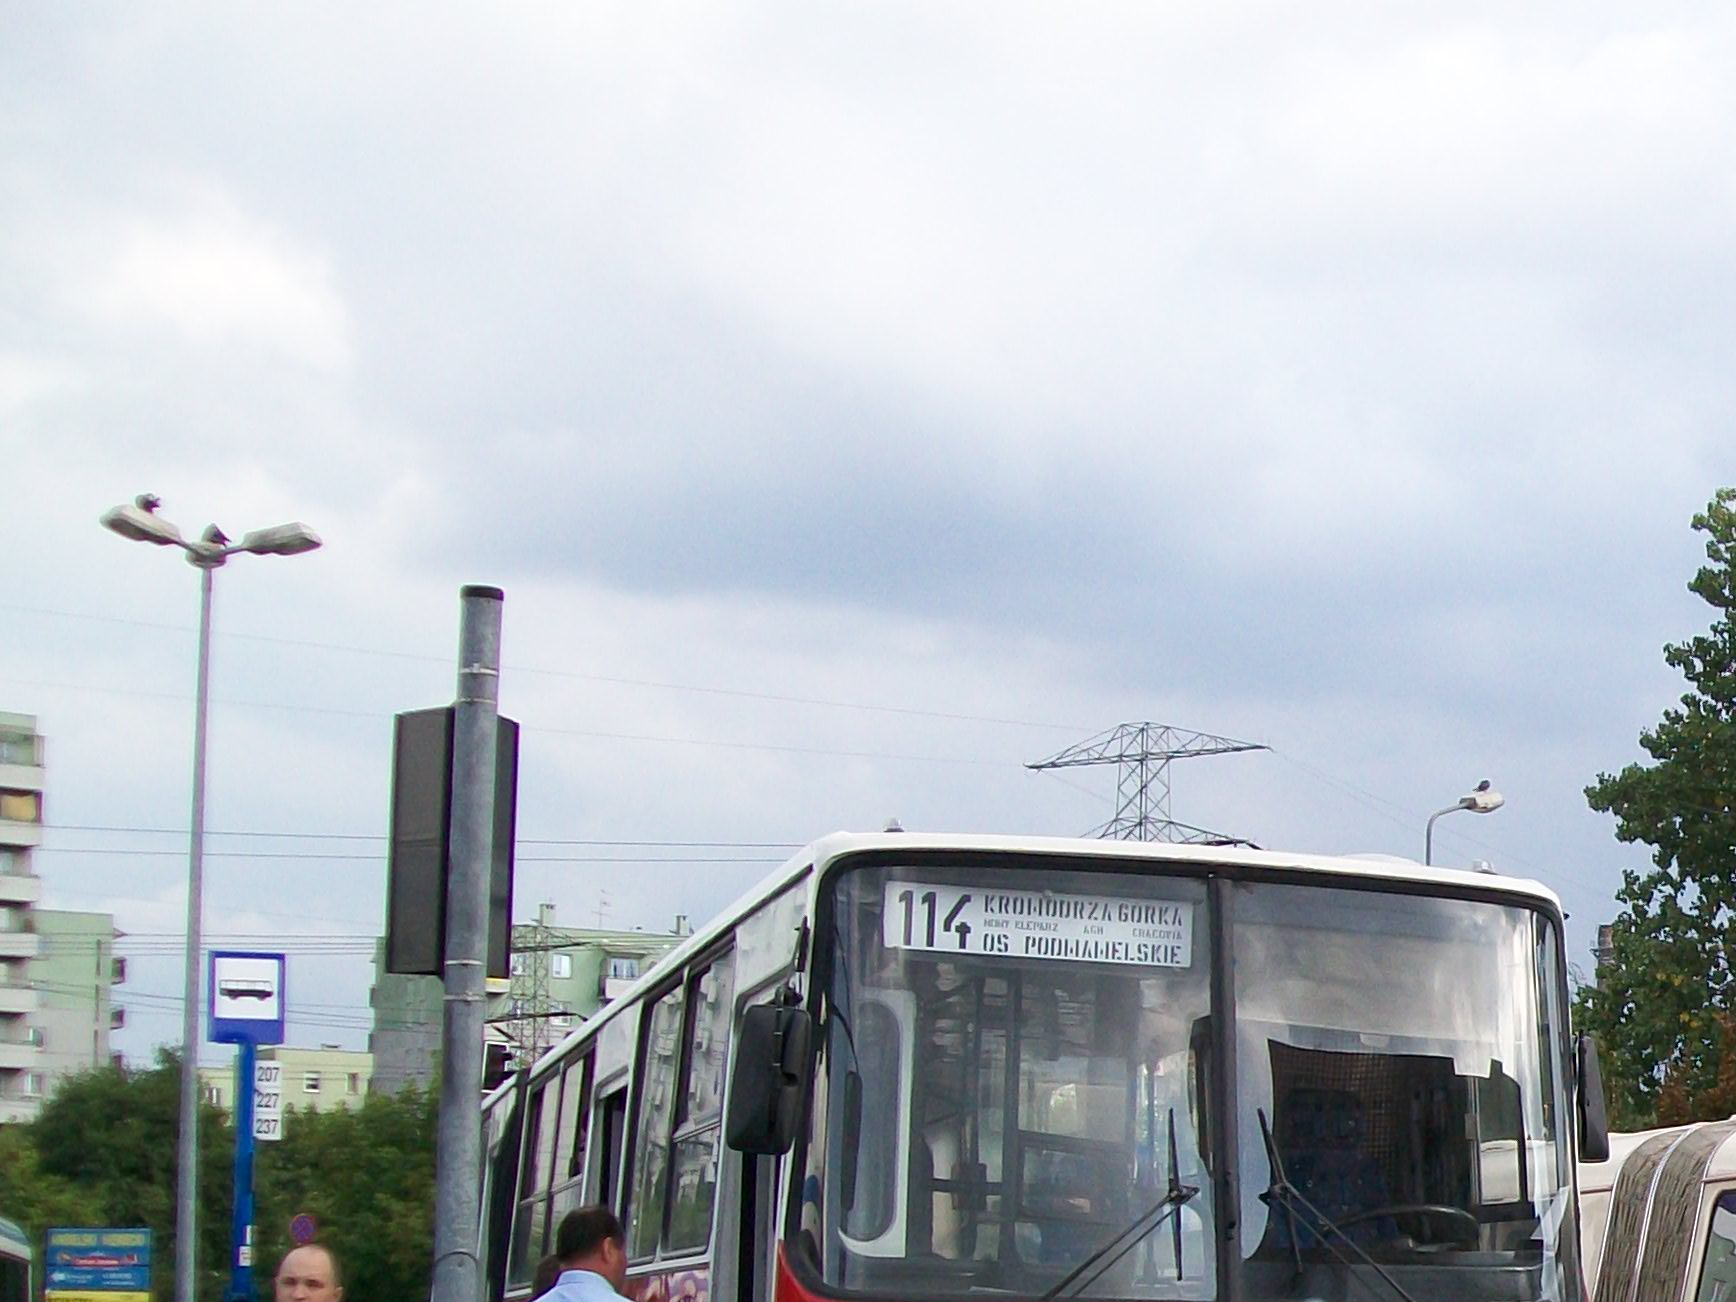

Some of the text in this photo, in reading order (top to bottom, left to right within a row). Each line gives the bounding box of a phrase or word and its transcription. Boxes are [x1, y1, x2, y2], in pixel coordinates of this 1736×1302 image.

[897, 889, 972, 950] 114
[1083, 924, 1105, 936] AGH
[1132, 927, 1183, 941] CRACOVIA
[1024, 935, 1182, 966] PODWAWELSKIE
[256, 1066, 280, 1082] 207
[256, 1092, 279, 1109] 227
[255, 1118, 279, 1135] 237
